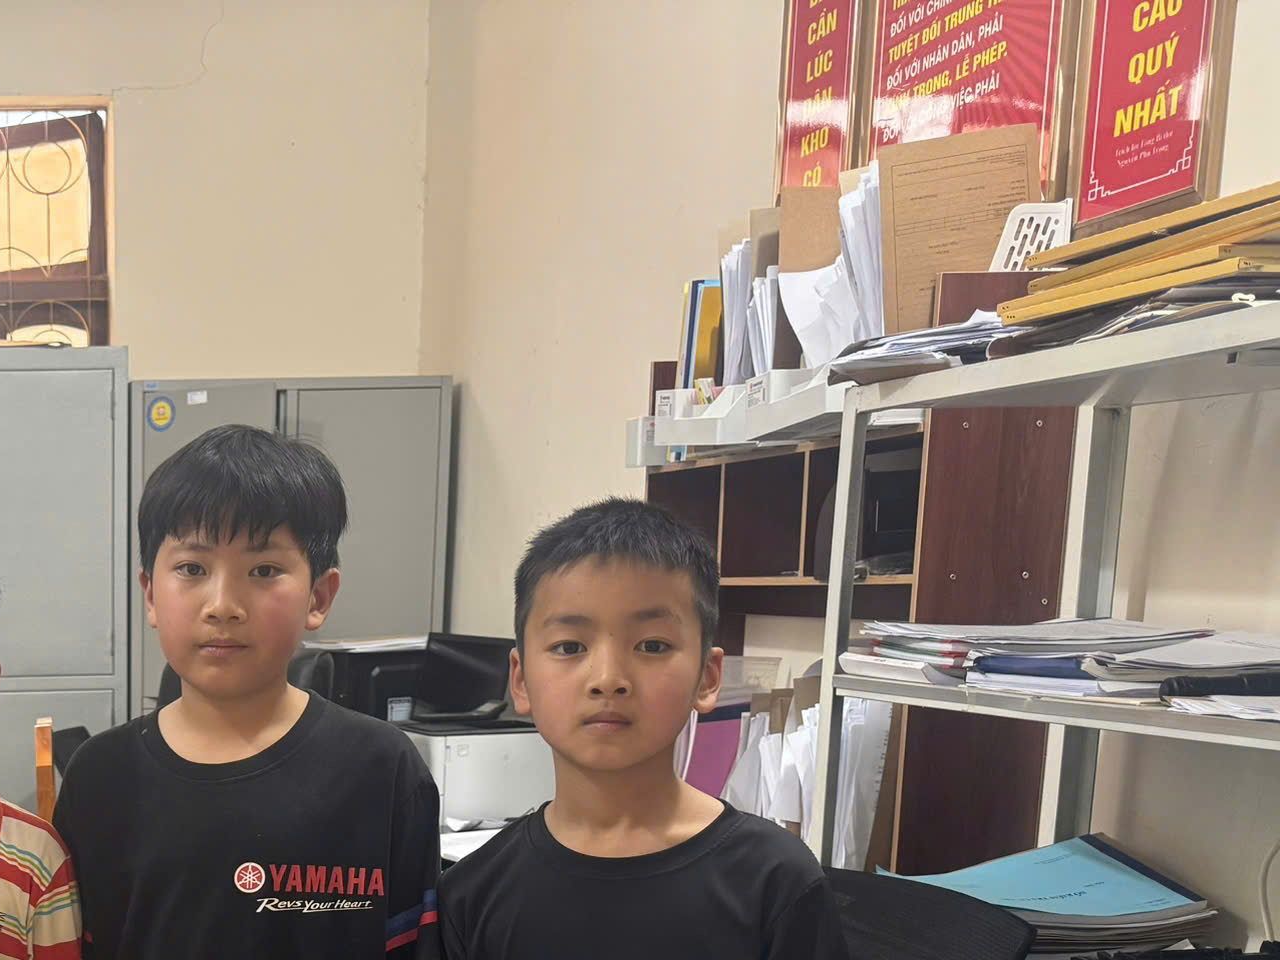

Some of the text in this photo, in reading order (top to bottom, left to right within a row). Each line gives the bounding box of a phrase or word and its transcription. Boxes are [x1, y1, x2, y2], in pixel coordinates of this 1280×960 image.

[888, 0, 983, 65] TUYỆT ĐỐI TRUNG
[1132, 0, 1183, 33] CAO
[922, 43, 949, 72] NHÂN
[977, 12, 1004, 43] PHẢI
[1128, 31, 1180, 85] QUÝ
[806, 49, 833, 84] LÚC
[1113, 80, 1184, 138] NHẤT
[270, 864, 384, 896] YAMAHA
[256, 898, 373, 913] Revs Your Heart
